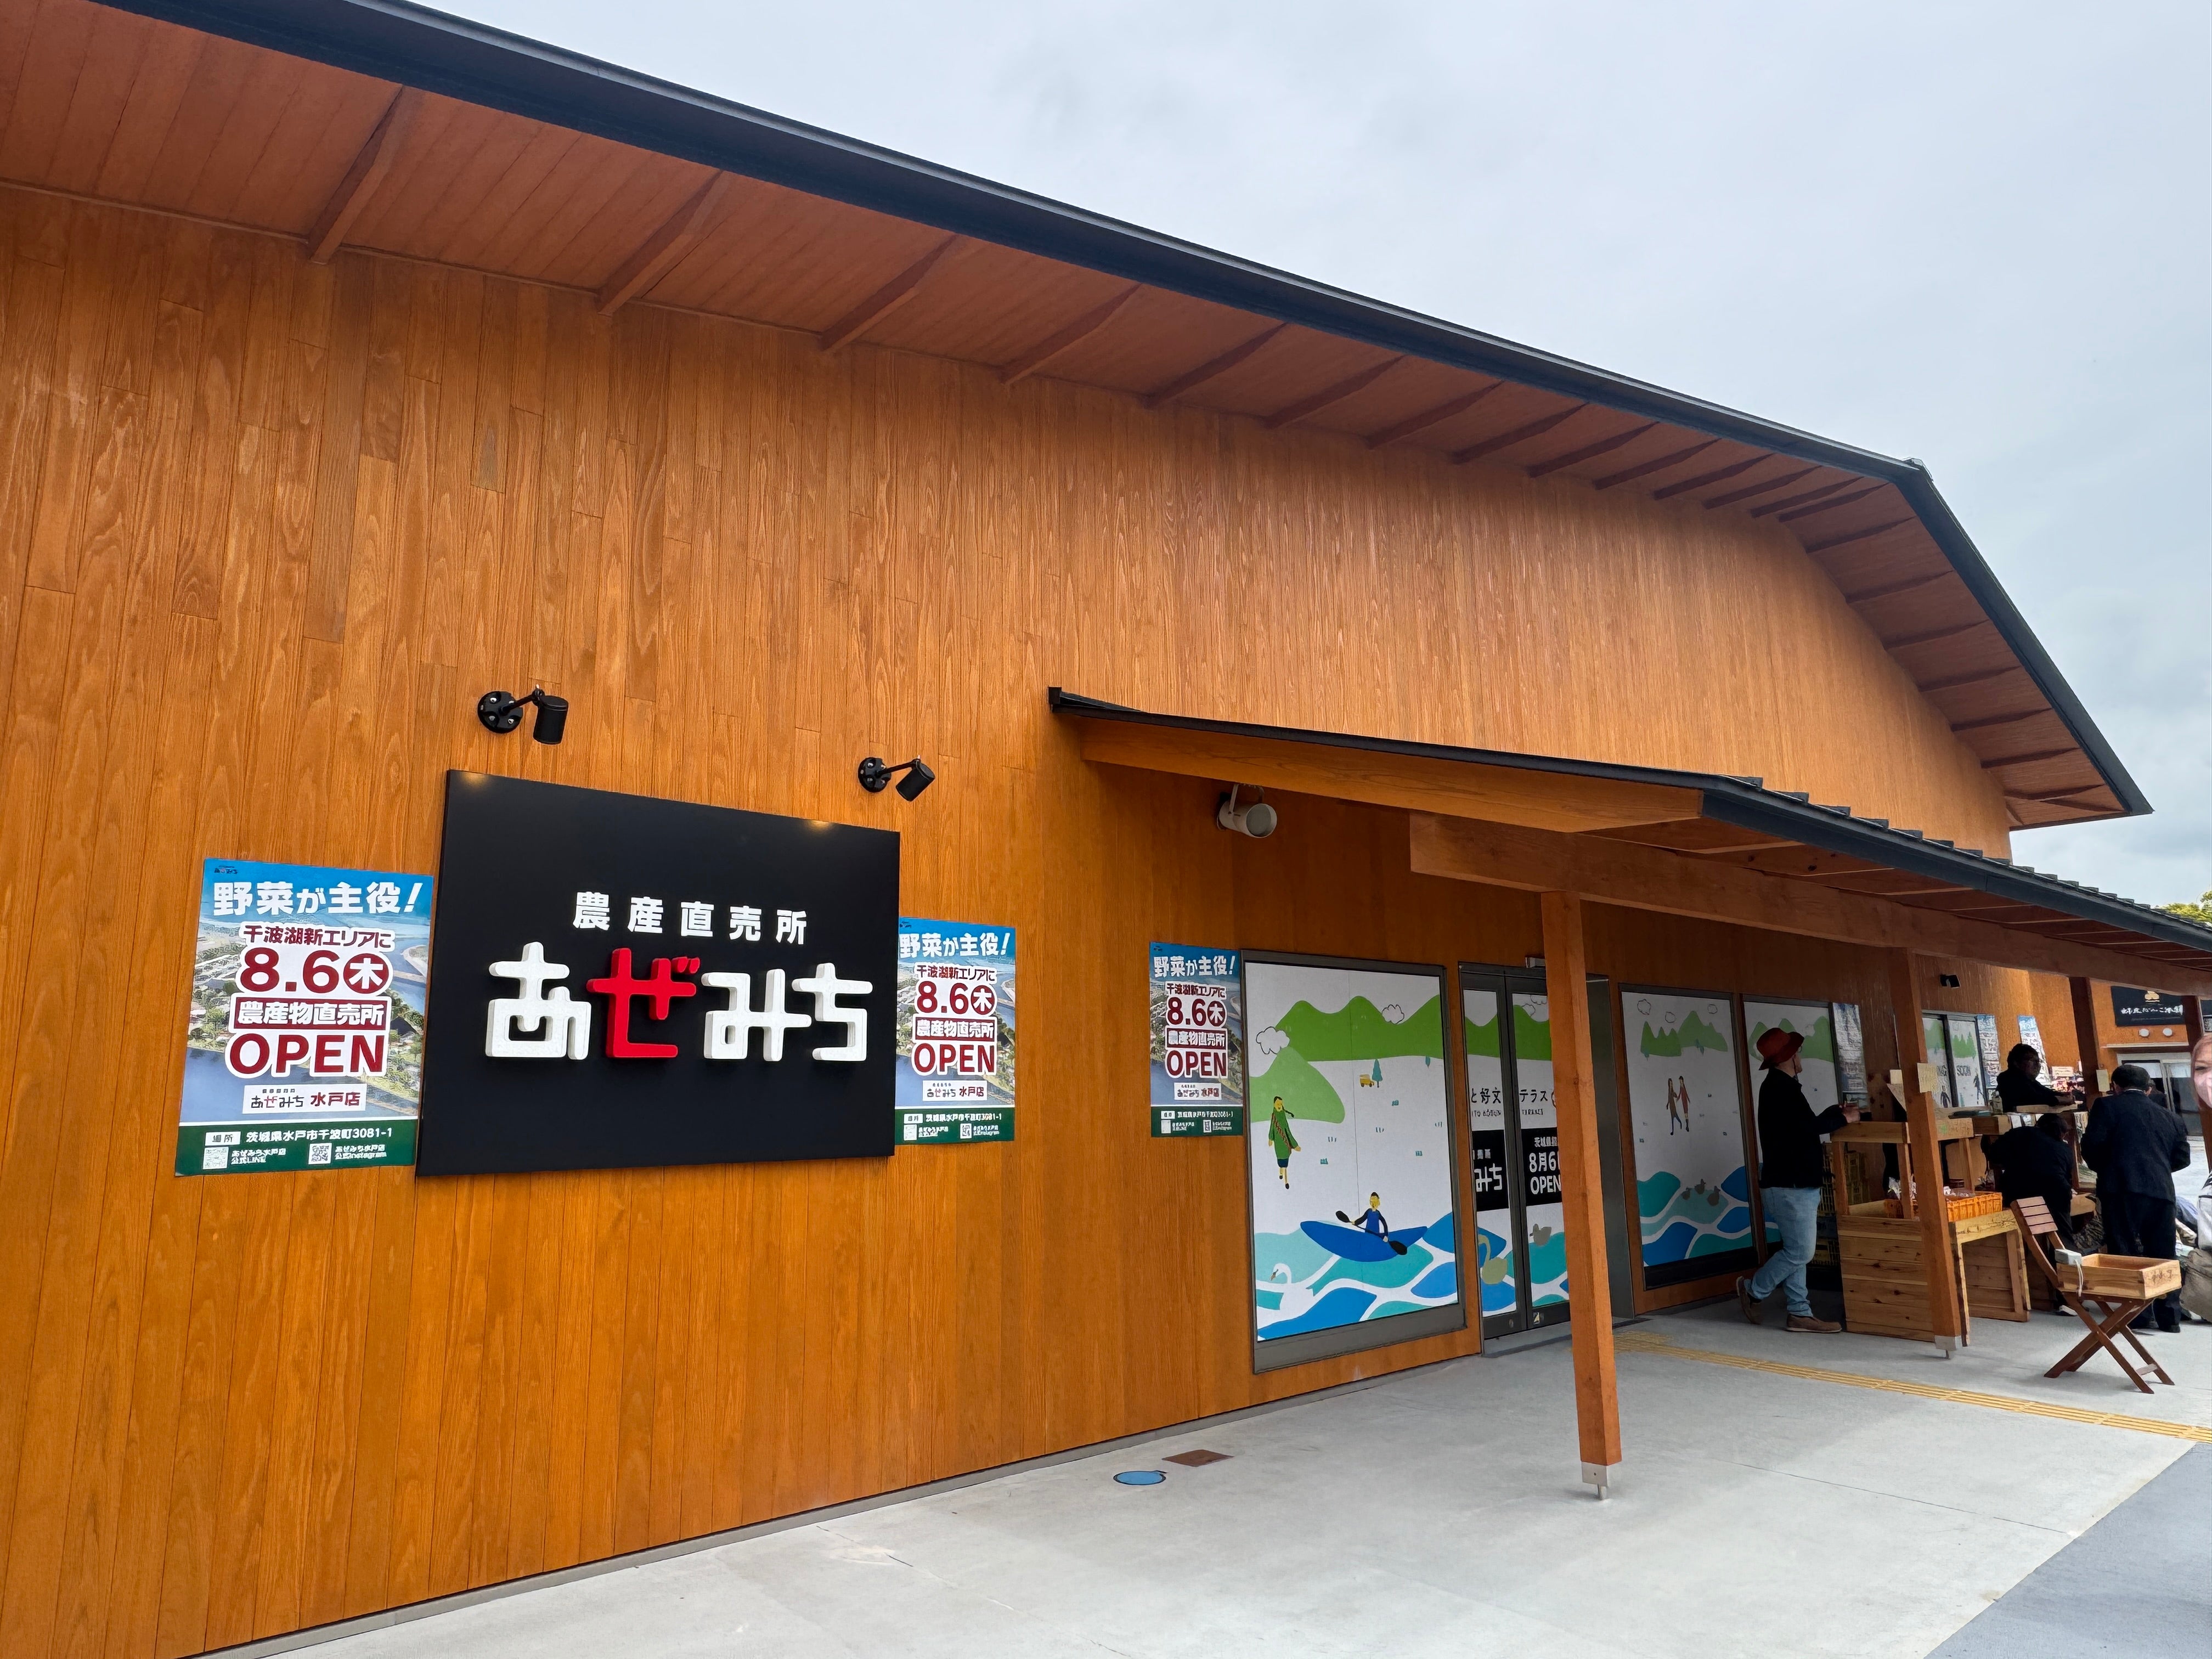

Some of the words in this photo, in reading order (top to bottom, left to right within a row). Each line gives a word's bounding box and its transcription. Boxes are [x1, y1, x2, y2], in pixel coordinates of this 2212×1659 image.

[213, 882, 423, 916] 野菜が主役!
[572, 891, 807, 945] 農産直売所
[243, 925, 391, 949] 千波湖新エリアに
[900, 933, 1010, 958] 野菜が主役!
[917, 965, 995, 981] 千波湖新エリアに
[1154, 955, 1235, 978] 野菜が主役!
[238, 1000, 384, 1026] 農産物直売所
[485, 941, 873, 1062] あぜみち
[916, 1019, 994, 1038] 農産物直売所
[230, 1034, 385, 1074] OPEN
[914, 1043, 995, 1073] OPEN
[1166, 1050, 1227, 1077] OPEN
[251, 1096, 304, 1108] あぜみち
[311, 1092, 360, 1107] 水戸店
[1519, 1089, 1548, 1103] テラス
[246, 1127, 392, 1143] 茨城県水戸市千波町3081-1
[1529, 1152, 1560, 1172] 8月6
[1530, 1175, 1561, 1194] OPEN
